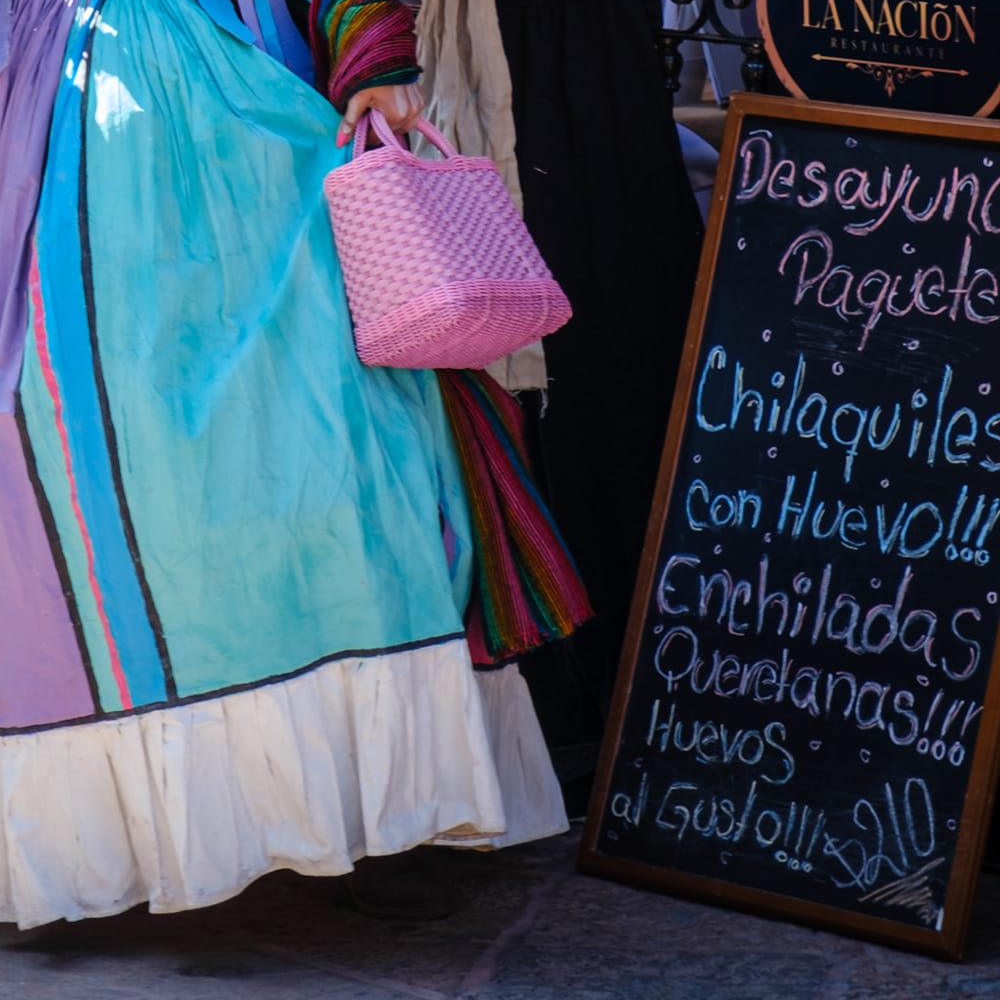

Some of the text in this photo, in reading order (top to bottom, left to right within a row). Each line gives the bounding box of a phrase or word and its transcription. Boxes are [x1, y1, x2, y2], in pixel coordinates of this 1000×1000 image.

[830, 37, 945, 60] RESTAURANTE
[611, 771, 650, 827] al
[823, 777, 936, 891] $210
